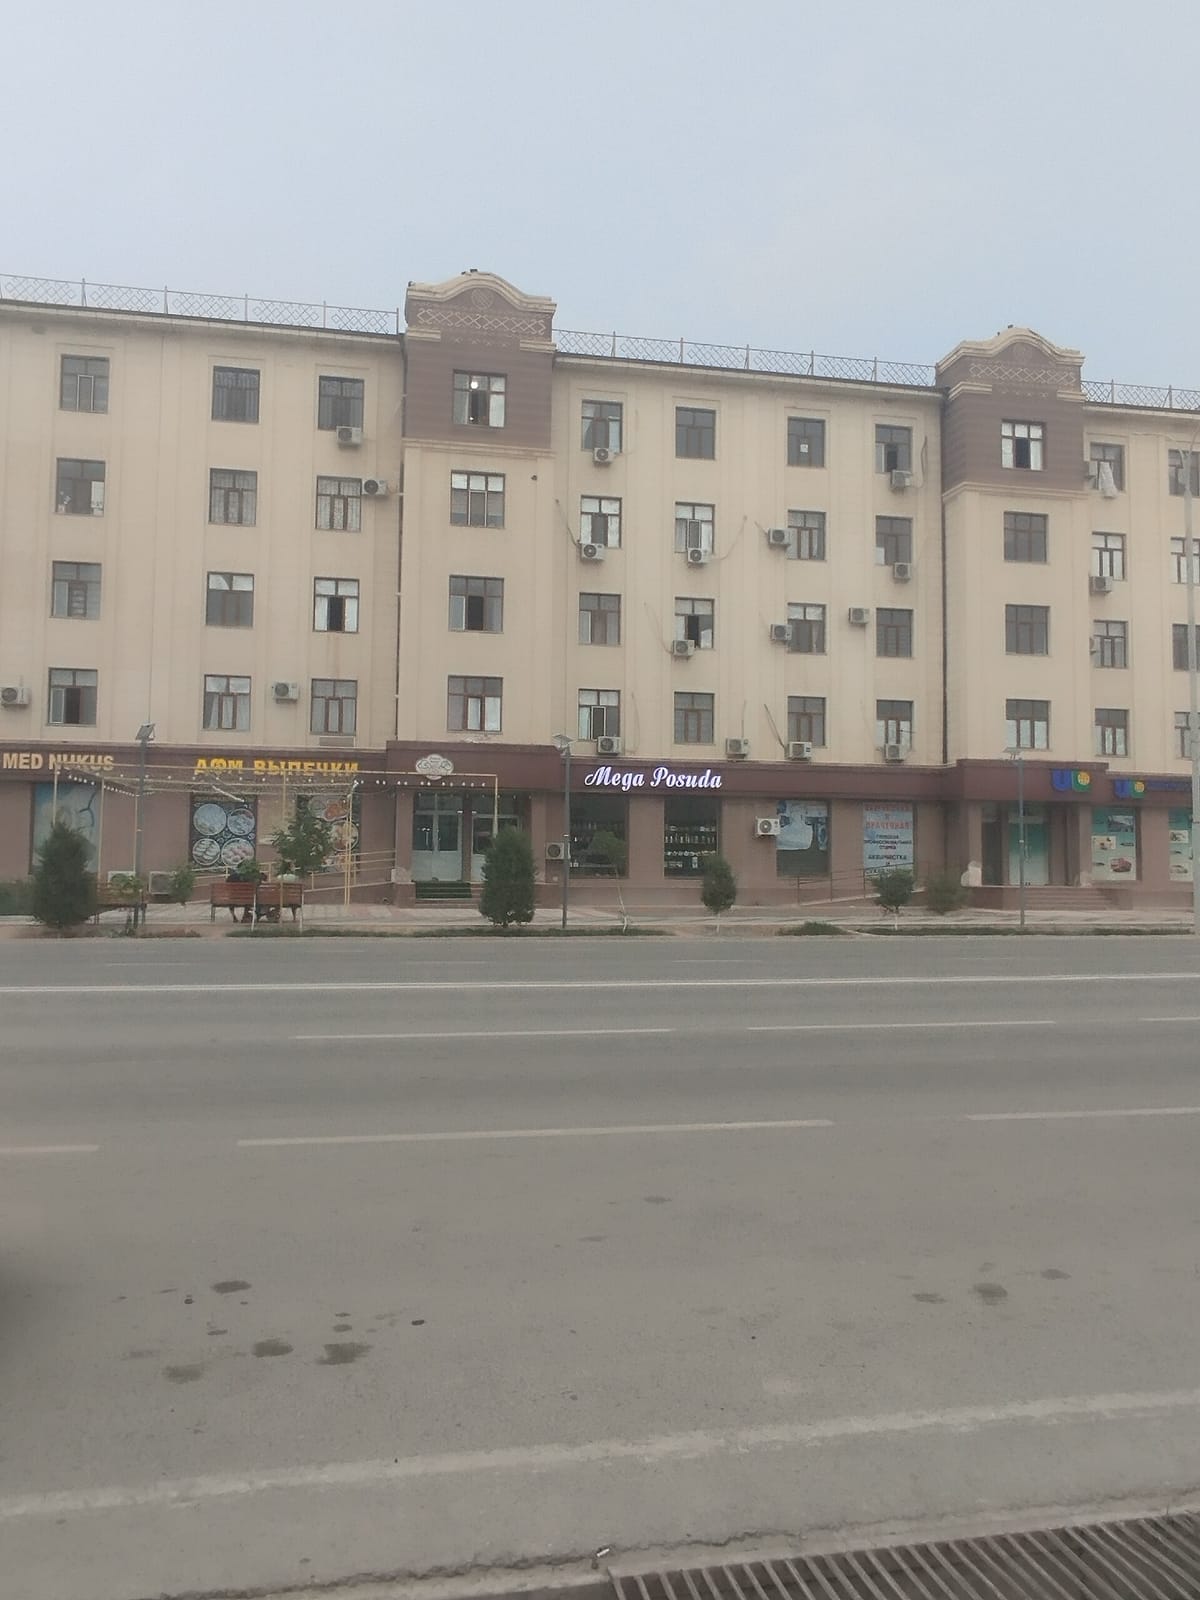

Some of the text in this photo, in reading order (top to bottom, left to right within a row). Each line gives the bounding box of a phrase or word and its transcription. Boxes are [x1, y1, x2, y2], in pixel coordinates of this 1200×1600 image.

[2, 752, 115, 771] MED NUKUS
[253, 759, 359, 777] ВЫПЕЧКИ
[584, 766, 723, 792] Mega Posuda
